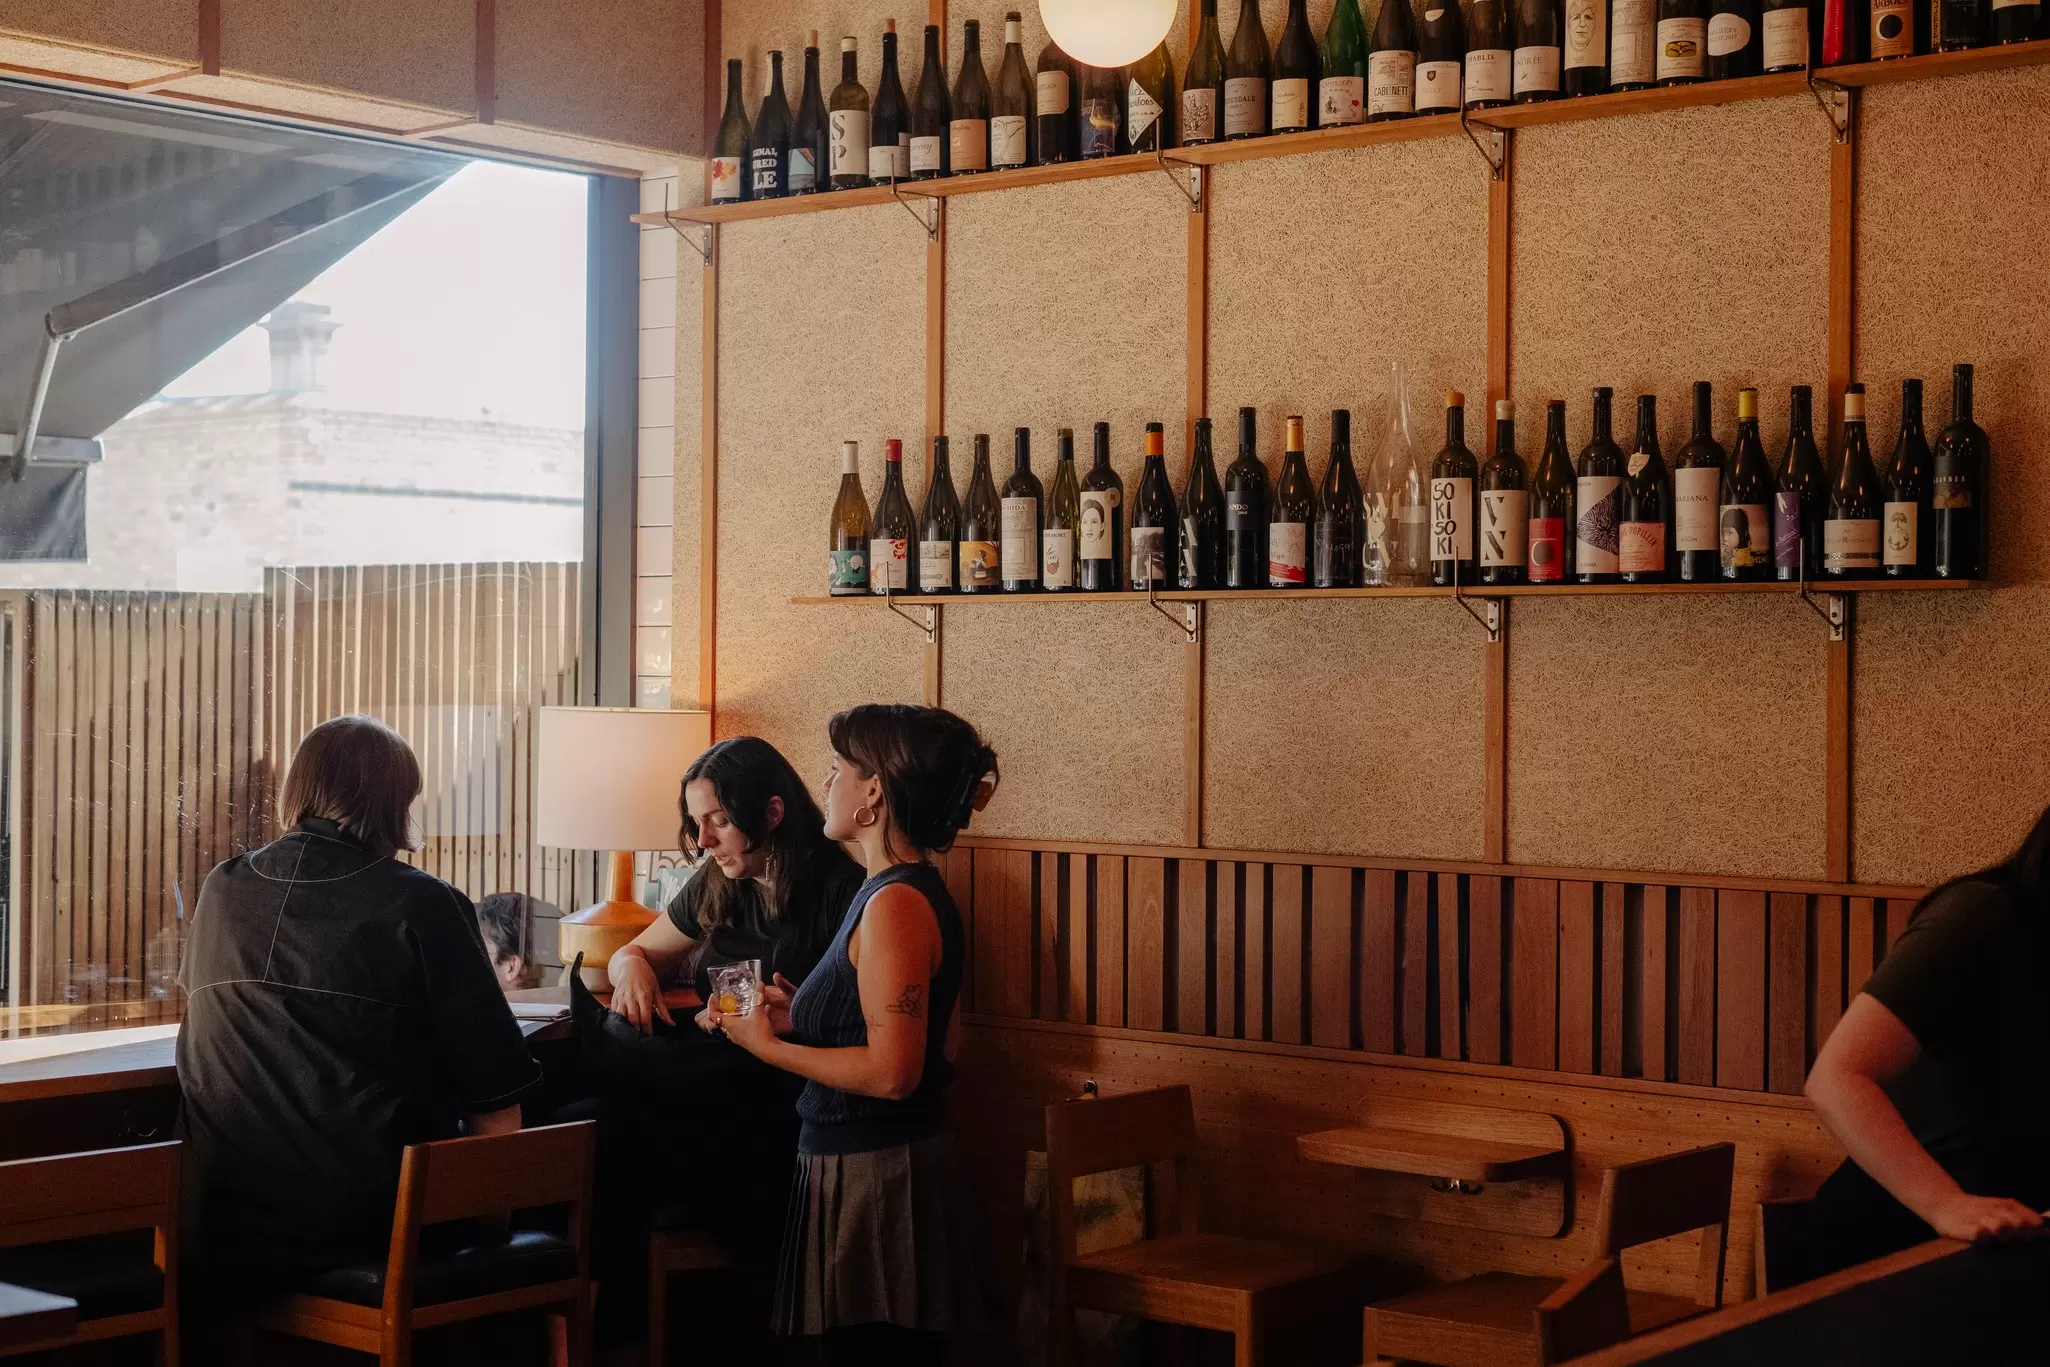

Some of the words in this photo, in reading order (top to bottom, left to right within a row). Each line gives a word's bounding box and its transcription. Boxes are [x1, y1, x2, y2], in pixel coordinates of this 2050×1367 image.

[1433, 482, 1455, 501] SO
[1435, 501, 1452, 520] KI
[1434, 520, 1457, 536] SO
[1437, 536, 1453, 555] KI
